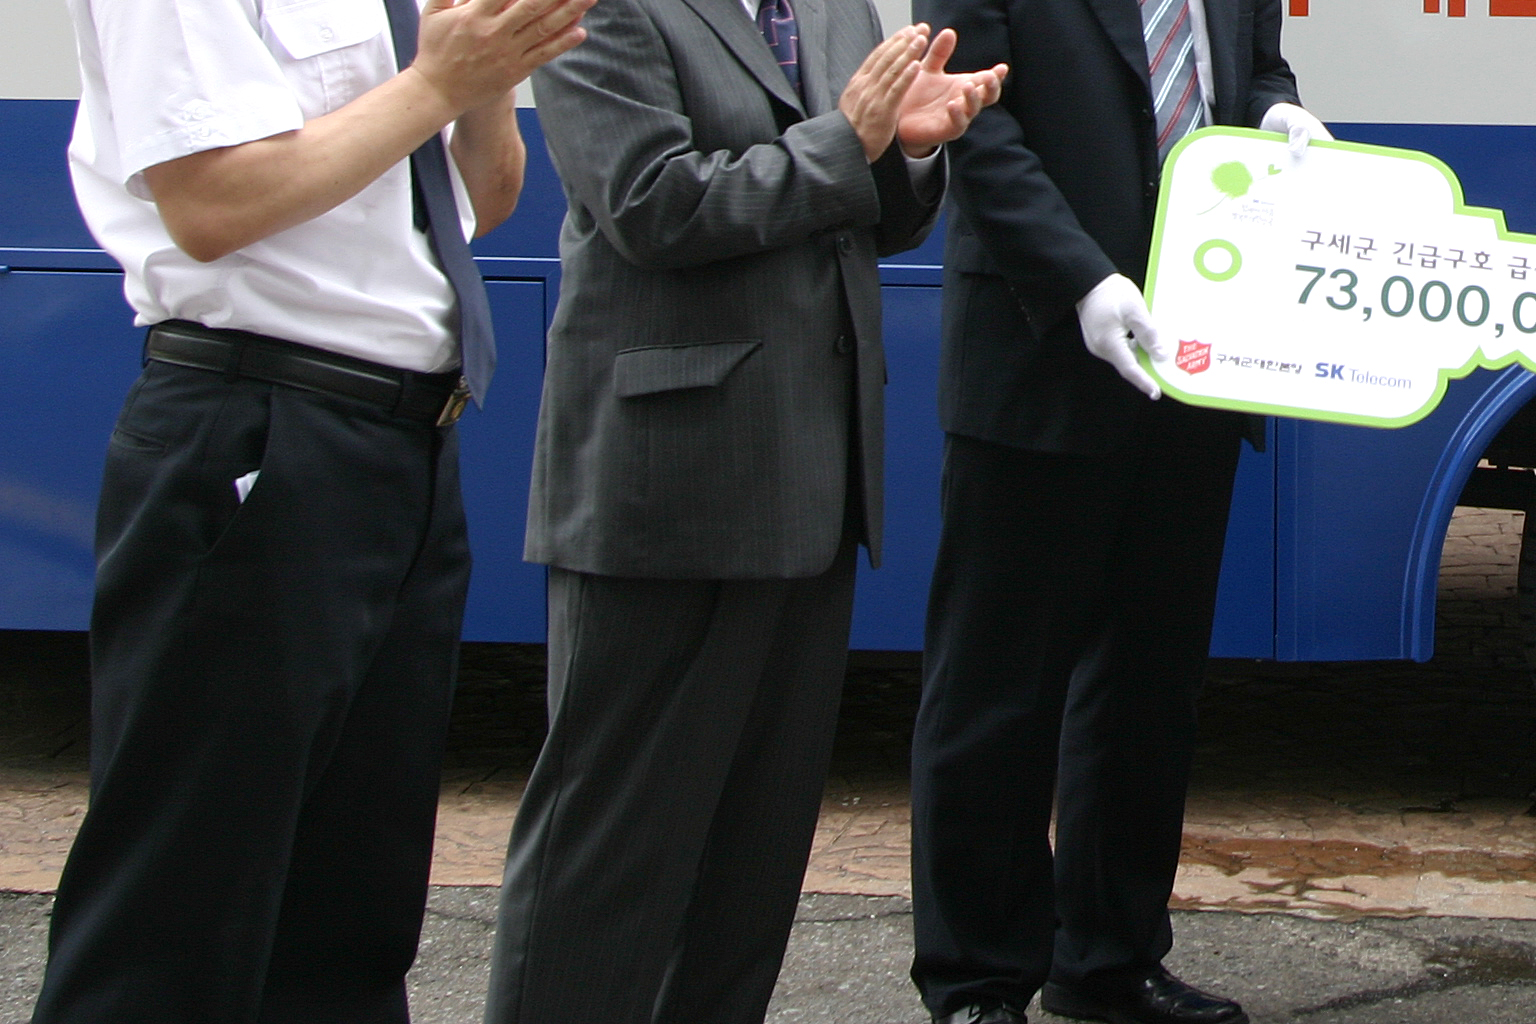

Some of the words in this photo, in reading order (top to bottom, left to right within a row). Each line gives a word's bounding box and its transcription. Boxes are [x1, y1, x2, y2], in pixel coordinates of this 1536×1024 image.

[1301, 230, 1378, 262] 구세군
[1393, 241, 1493, 272] 긴급구호
[1315, 362, 1345, 381] SK
